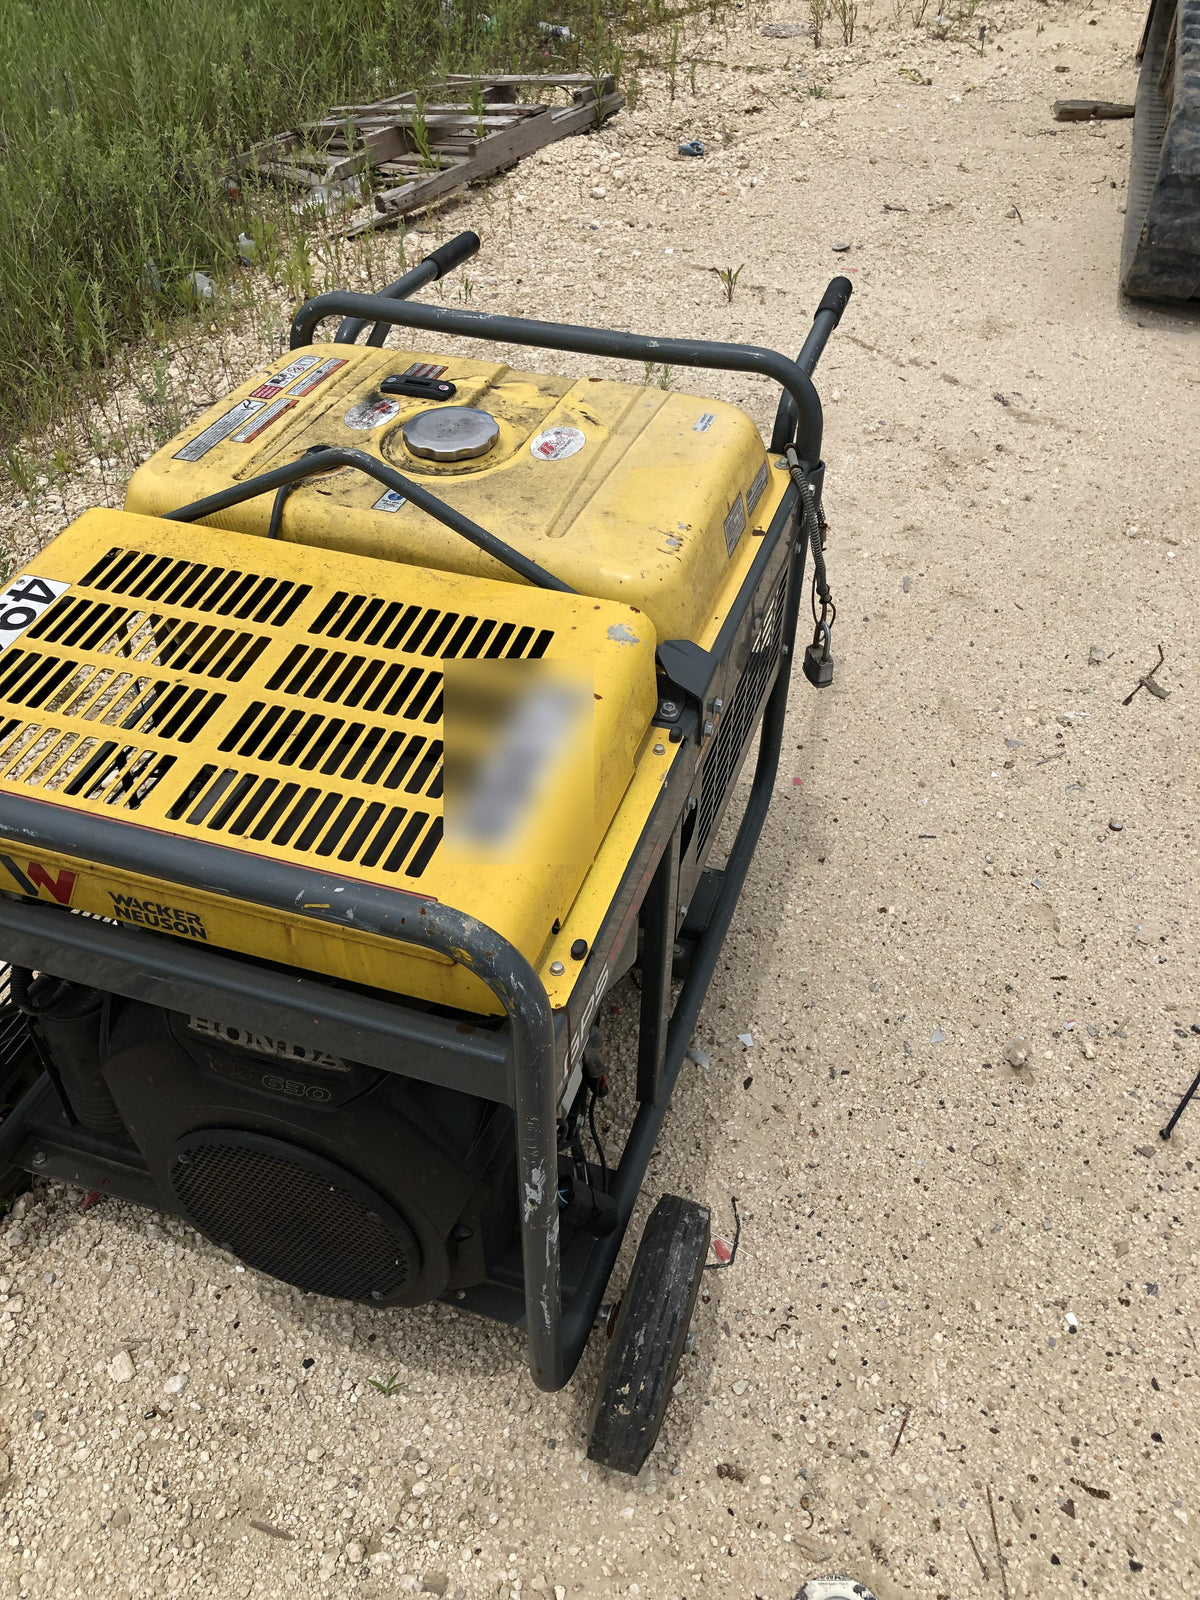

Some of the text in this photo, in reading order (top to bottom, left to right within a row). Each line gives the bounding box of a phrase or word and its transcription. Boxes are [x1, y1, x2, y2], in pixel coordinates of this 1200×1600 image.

[0, 579, 56, 651] 49
[107, 891, 204, 927] WACKER
[114, 904, 208, 940] NEUSON
[187, 1015, 349, 1073] HONDA
[262, 1074, 331, 1101] 630
